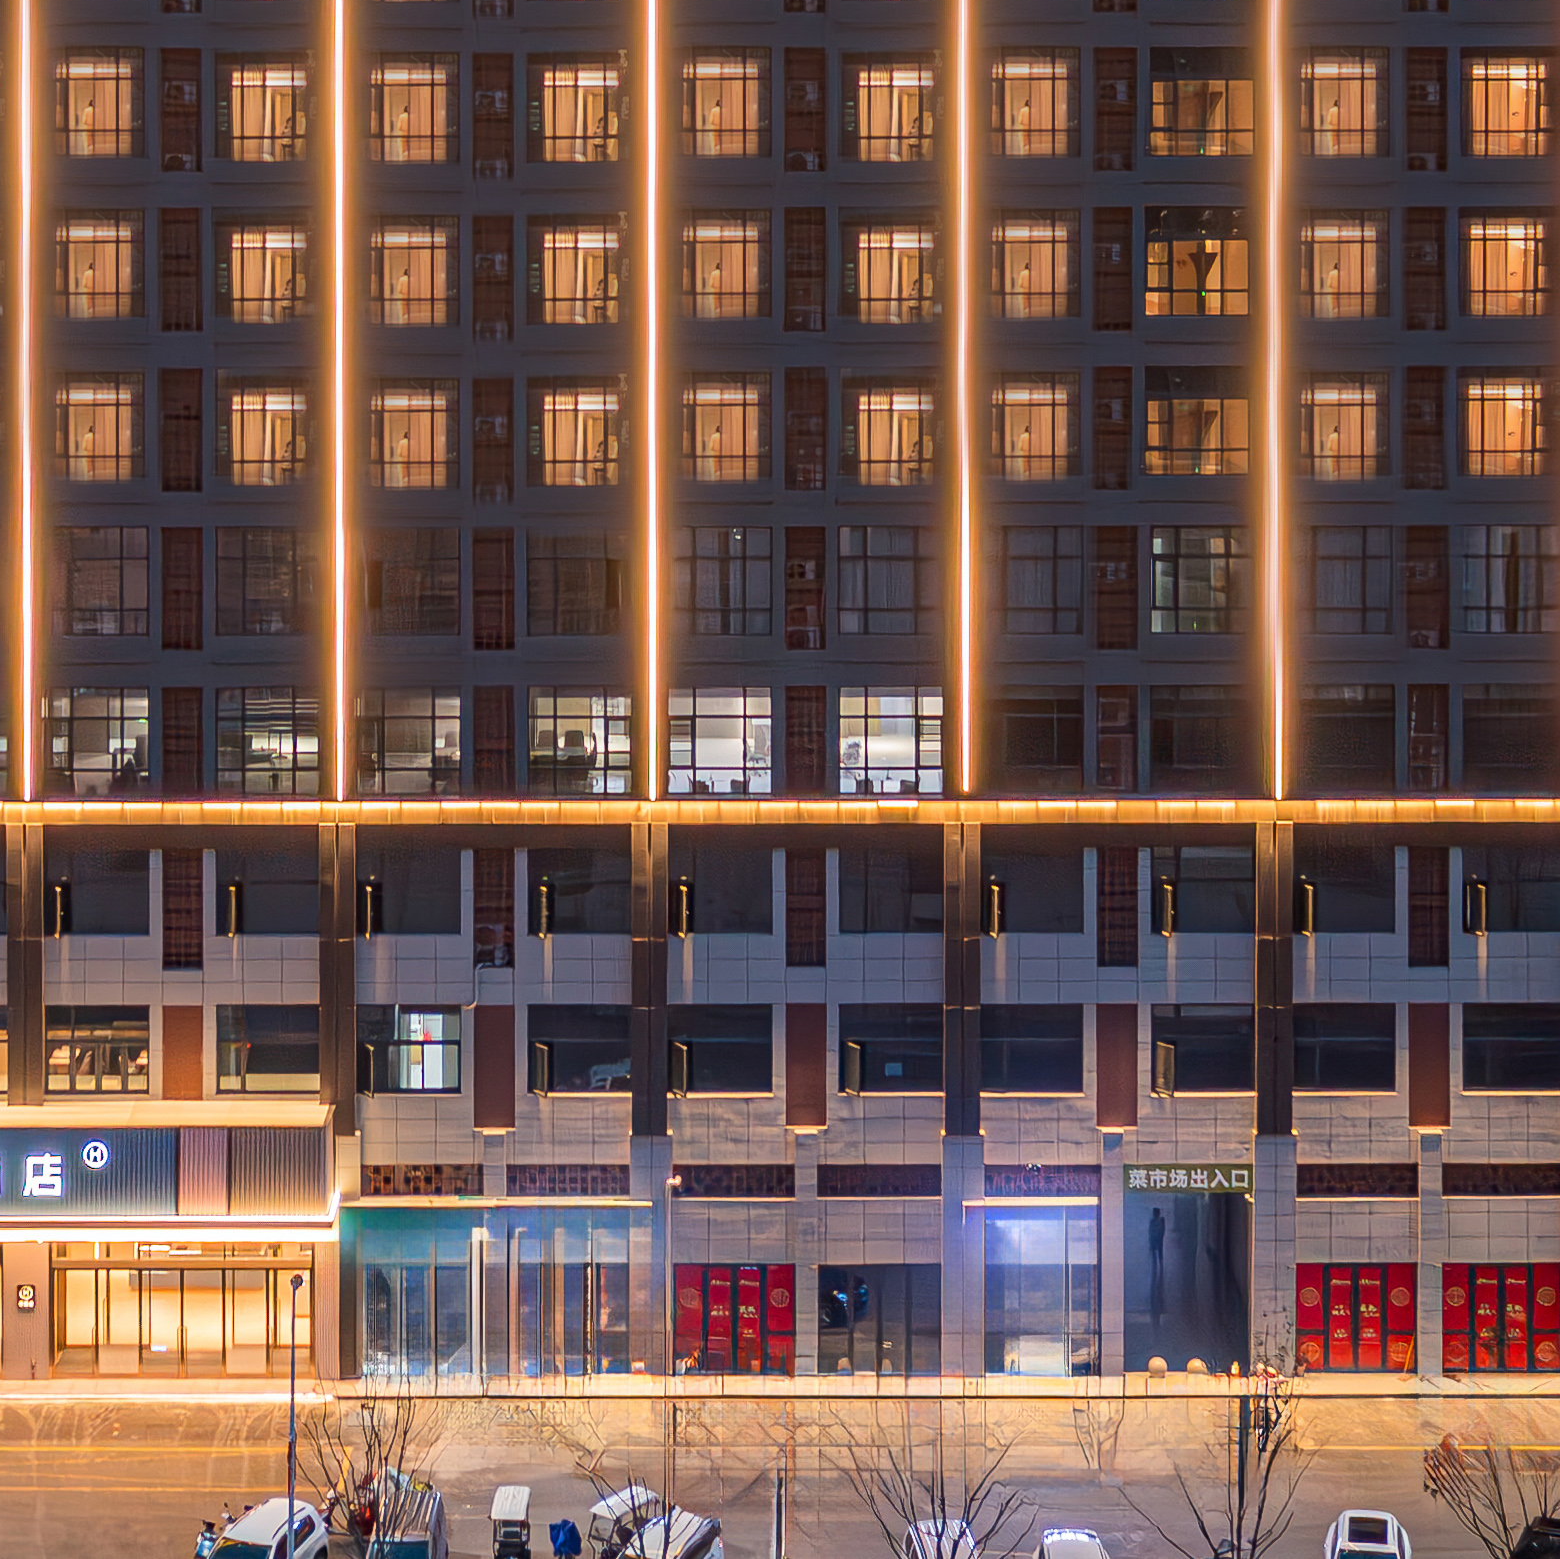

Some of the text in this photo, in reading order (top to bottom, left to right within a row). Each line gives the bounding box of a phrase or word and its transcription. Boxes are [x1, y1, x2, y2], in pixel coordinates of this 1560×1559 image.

[1128, 1168, 1249, 1189] 菜市场出入口
